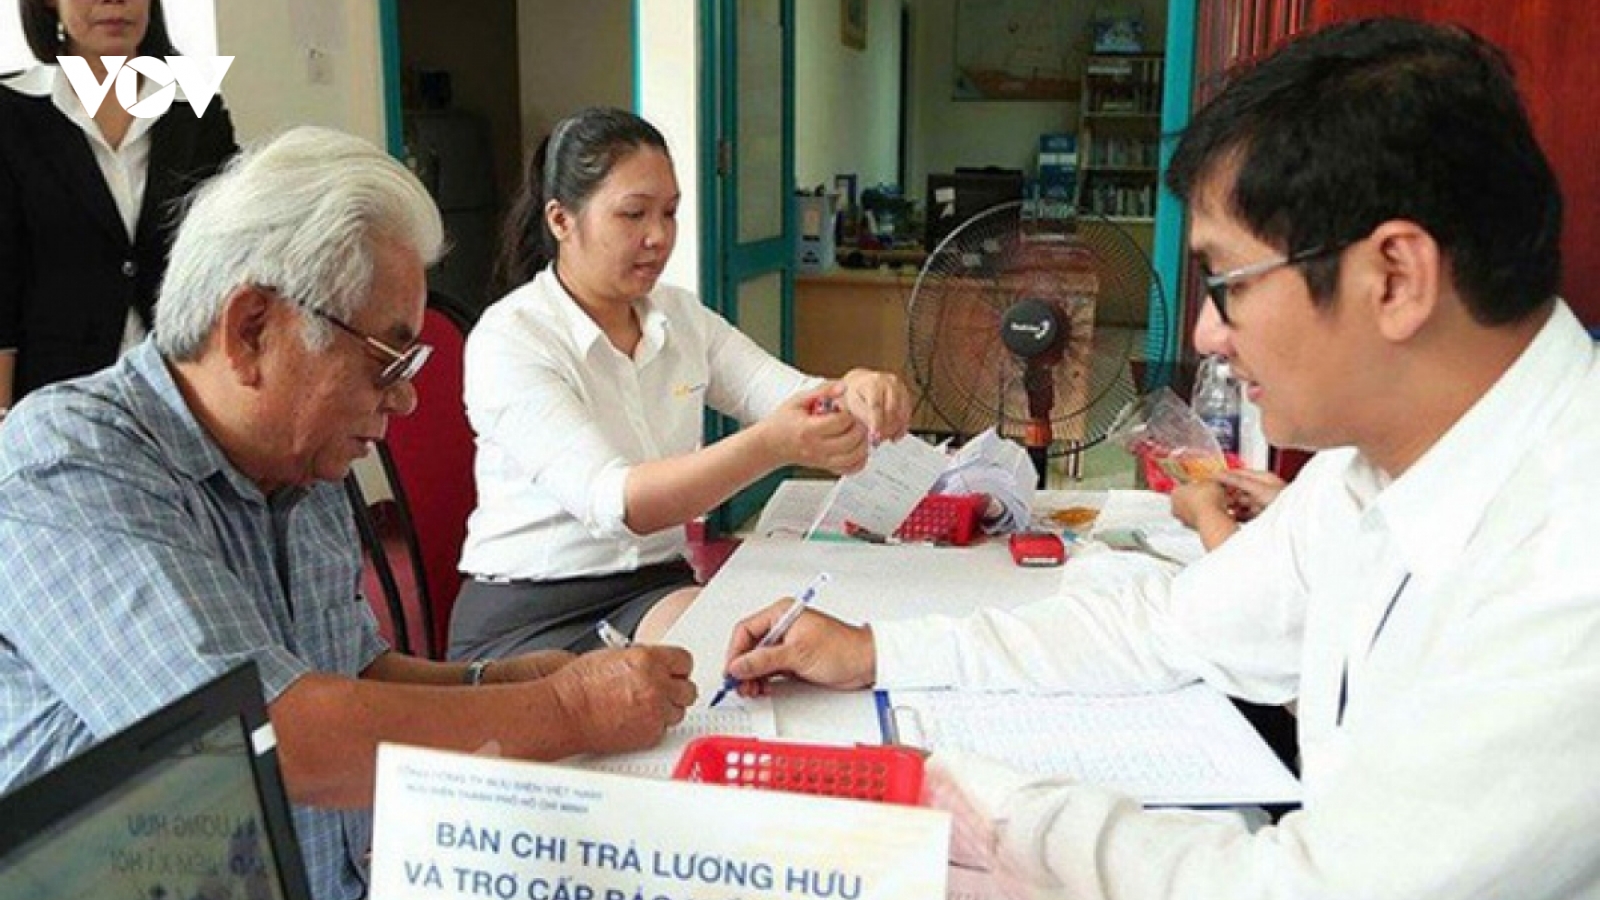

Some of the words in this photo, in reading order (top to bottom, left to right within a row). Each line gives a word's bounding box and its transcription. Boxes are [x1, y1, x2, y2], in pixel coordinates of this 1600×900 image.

[404, 859, 443, 889] VÀ
[436, 820, 501, 855] BÀN
[511, 832, 566, 863] CHI
[577, 839, 642, 873] TRẢ
[652, 849, 774, 891] LƯƠNG
[785, 866, 862, 900] HƯU
